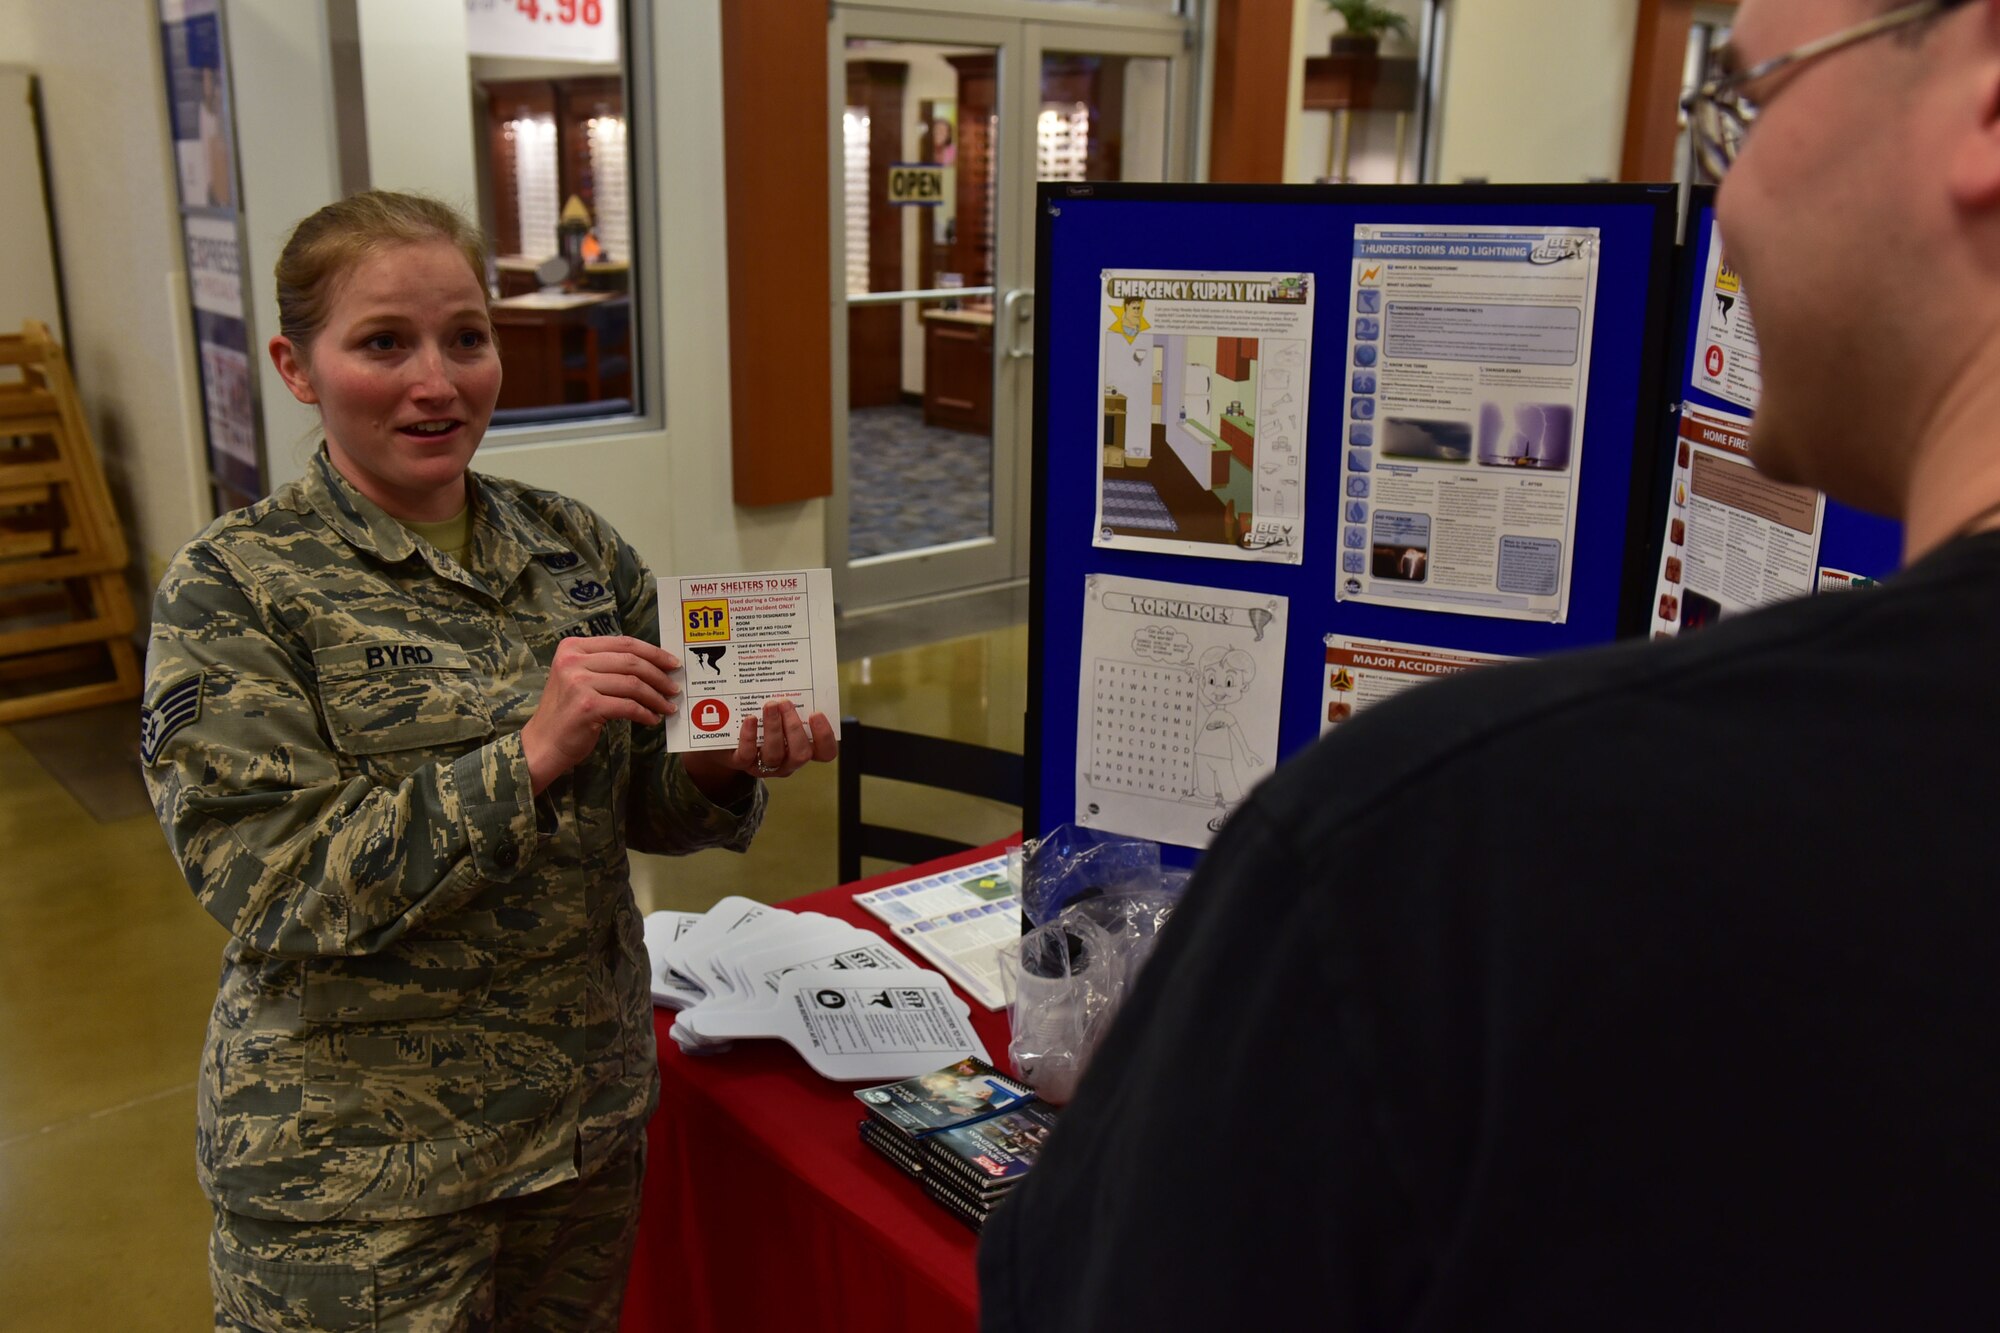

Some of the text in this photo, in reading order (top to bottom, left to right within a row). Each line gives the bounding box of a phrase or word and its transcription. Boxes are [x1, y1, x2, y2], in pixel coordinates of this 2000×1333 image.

[893, 172, 941, 196] OPEN
[1360, 244, 1528, 257] THUNDERSTORMS AND LIGHTNING
[1548, 239, 1571, 248] BE
[1114, 280, 1271, 301] EMERGENCY SUPPLY KIT
[1703, 429, 1750, 452] HOME FIRES
[1256, 522, 1280, 534] BE
[690, 578, 797, 592] WHAT SHELTERS TO USE
[1131, 597, 1233, 624] TORNADOES
[365, 645, 433, 669] BYRD
[1353, 654, 1395, 668] MAJOR
[693, 732, 730, 740] LOCKDOWN
[889, 1088, 915, 1104] PLANS
[896, 1085, 921, 1102] FAMILY
[921, 1101, 943, 1116] CARE
[968, 1130, 1015, 1162] PREPAREDNESS
[972, 1141, 1006, 1165] TORNADO
